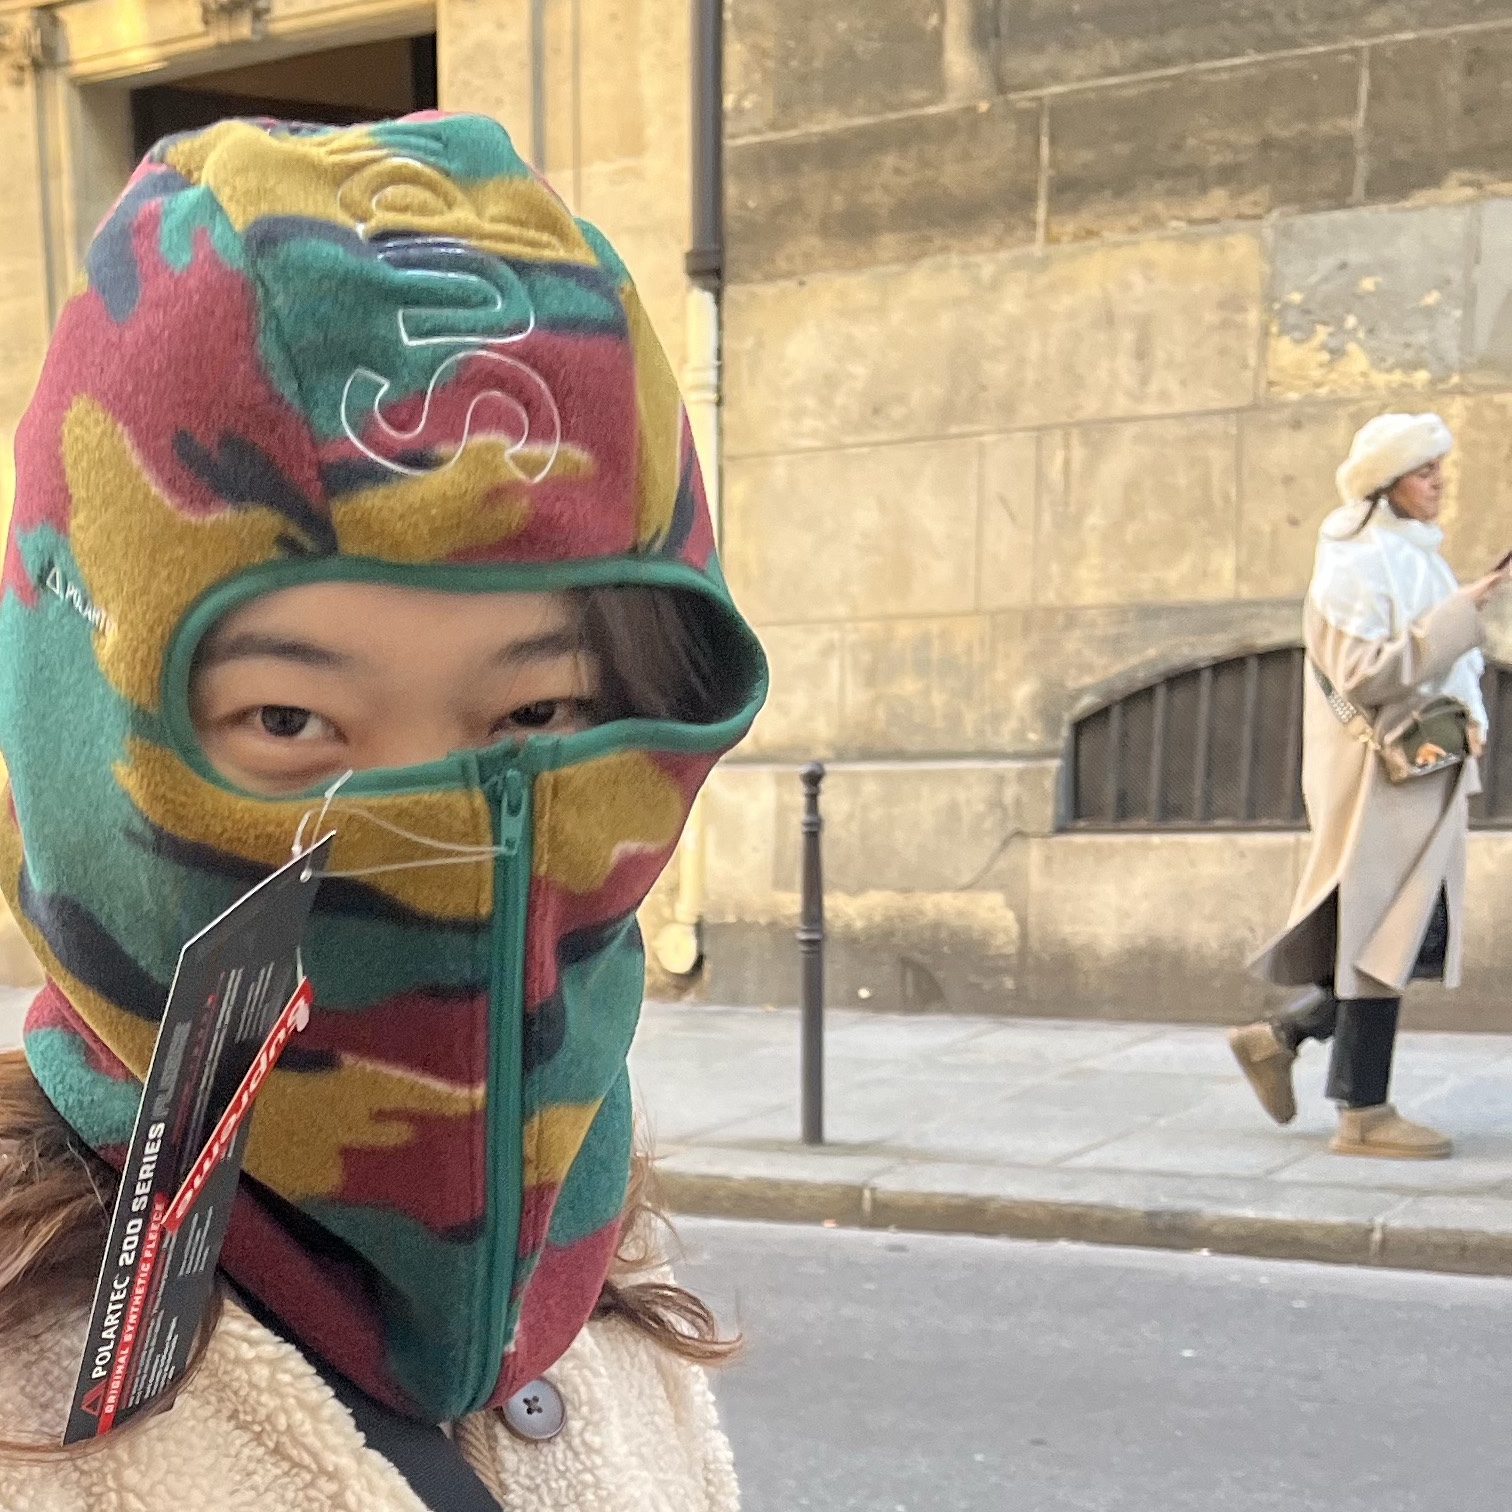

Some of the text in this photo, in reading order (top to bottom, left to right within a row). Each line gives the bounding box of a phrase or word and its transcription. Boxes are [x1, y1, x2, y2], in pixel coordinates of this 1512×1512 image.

[91, 1274, 130, 1380] POLARTEC
[118, 1218, 143, 1268] 200
[131, 1121, 166, 1213] SERIES
[104, 1347, 130, 1415] ORIGINAL
[122, 1260, 151, 1343] SYNTHETIC
[143, 1203, 165, 1258] FLEECE
